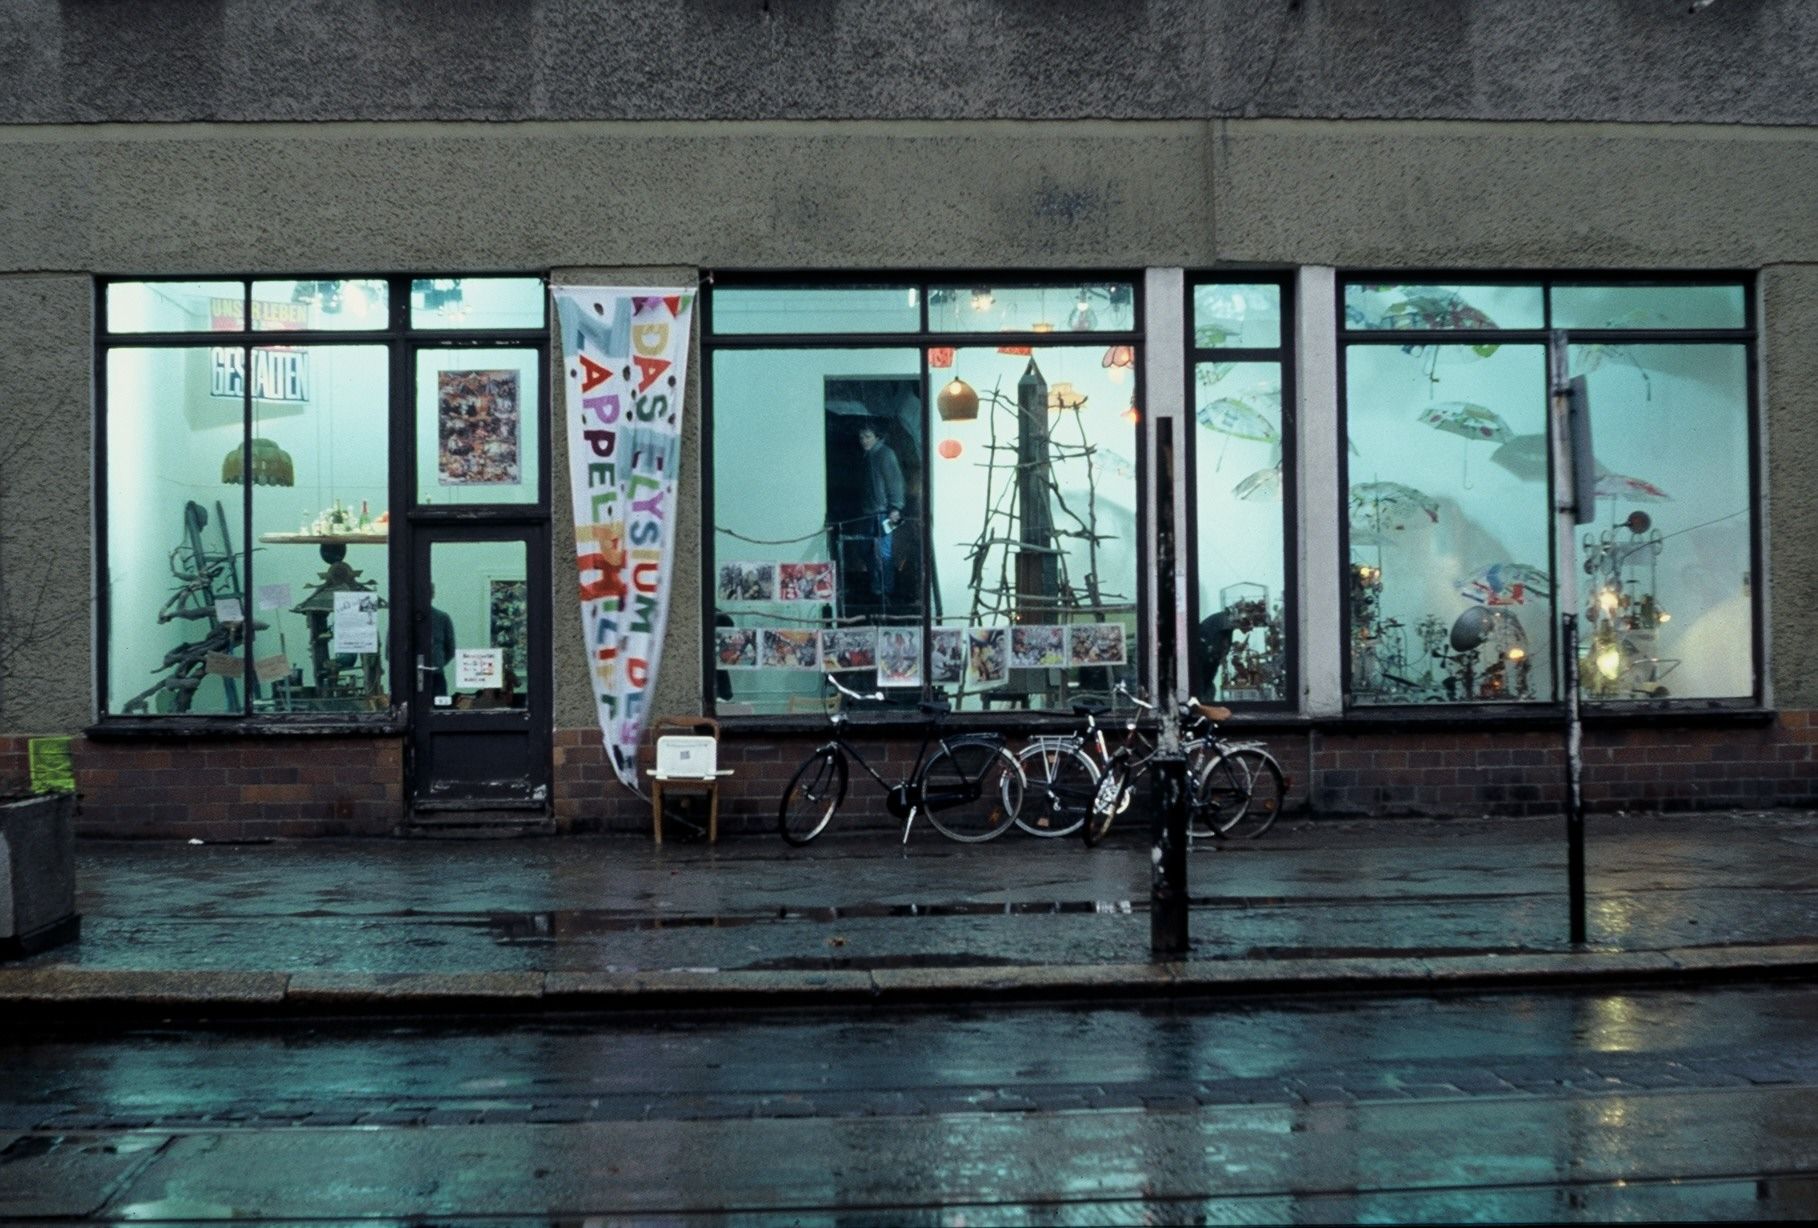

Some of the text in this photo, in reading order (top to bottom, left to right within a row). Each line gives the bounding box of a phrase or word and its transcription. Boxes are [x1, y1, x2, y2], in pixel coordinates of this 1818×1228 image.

[212, 299, 305, 323] UNSR LEBEN
[632, 322, 673, 423] DAS
[616, 427, 682, 633] ELYSIUM
